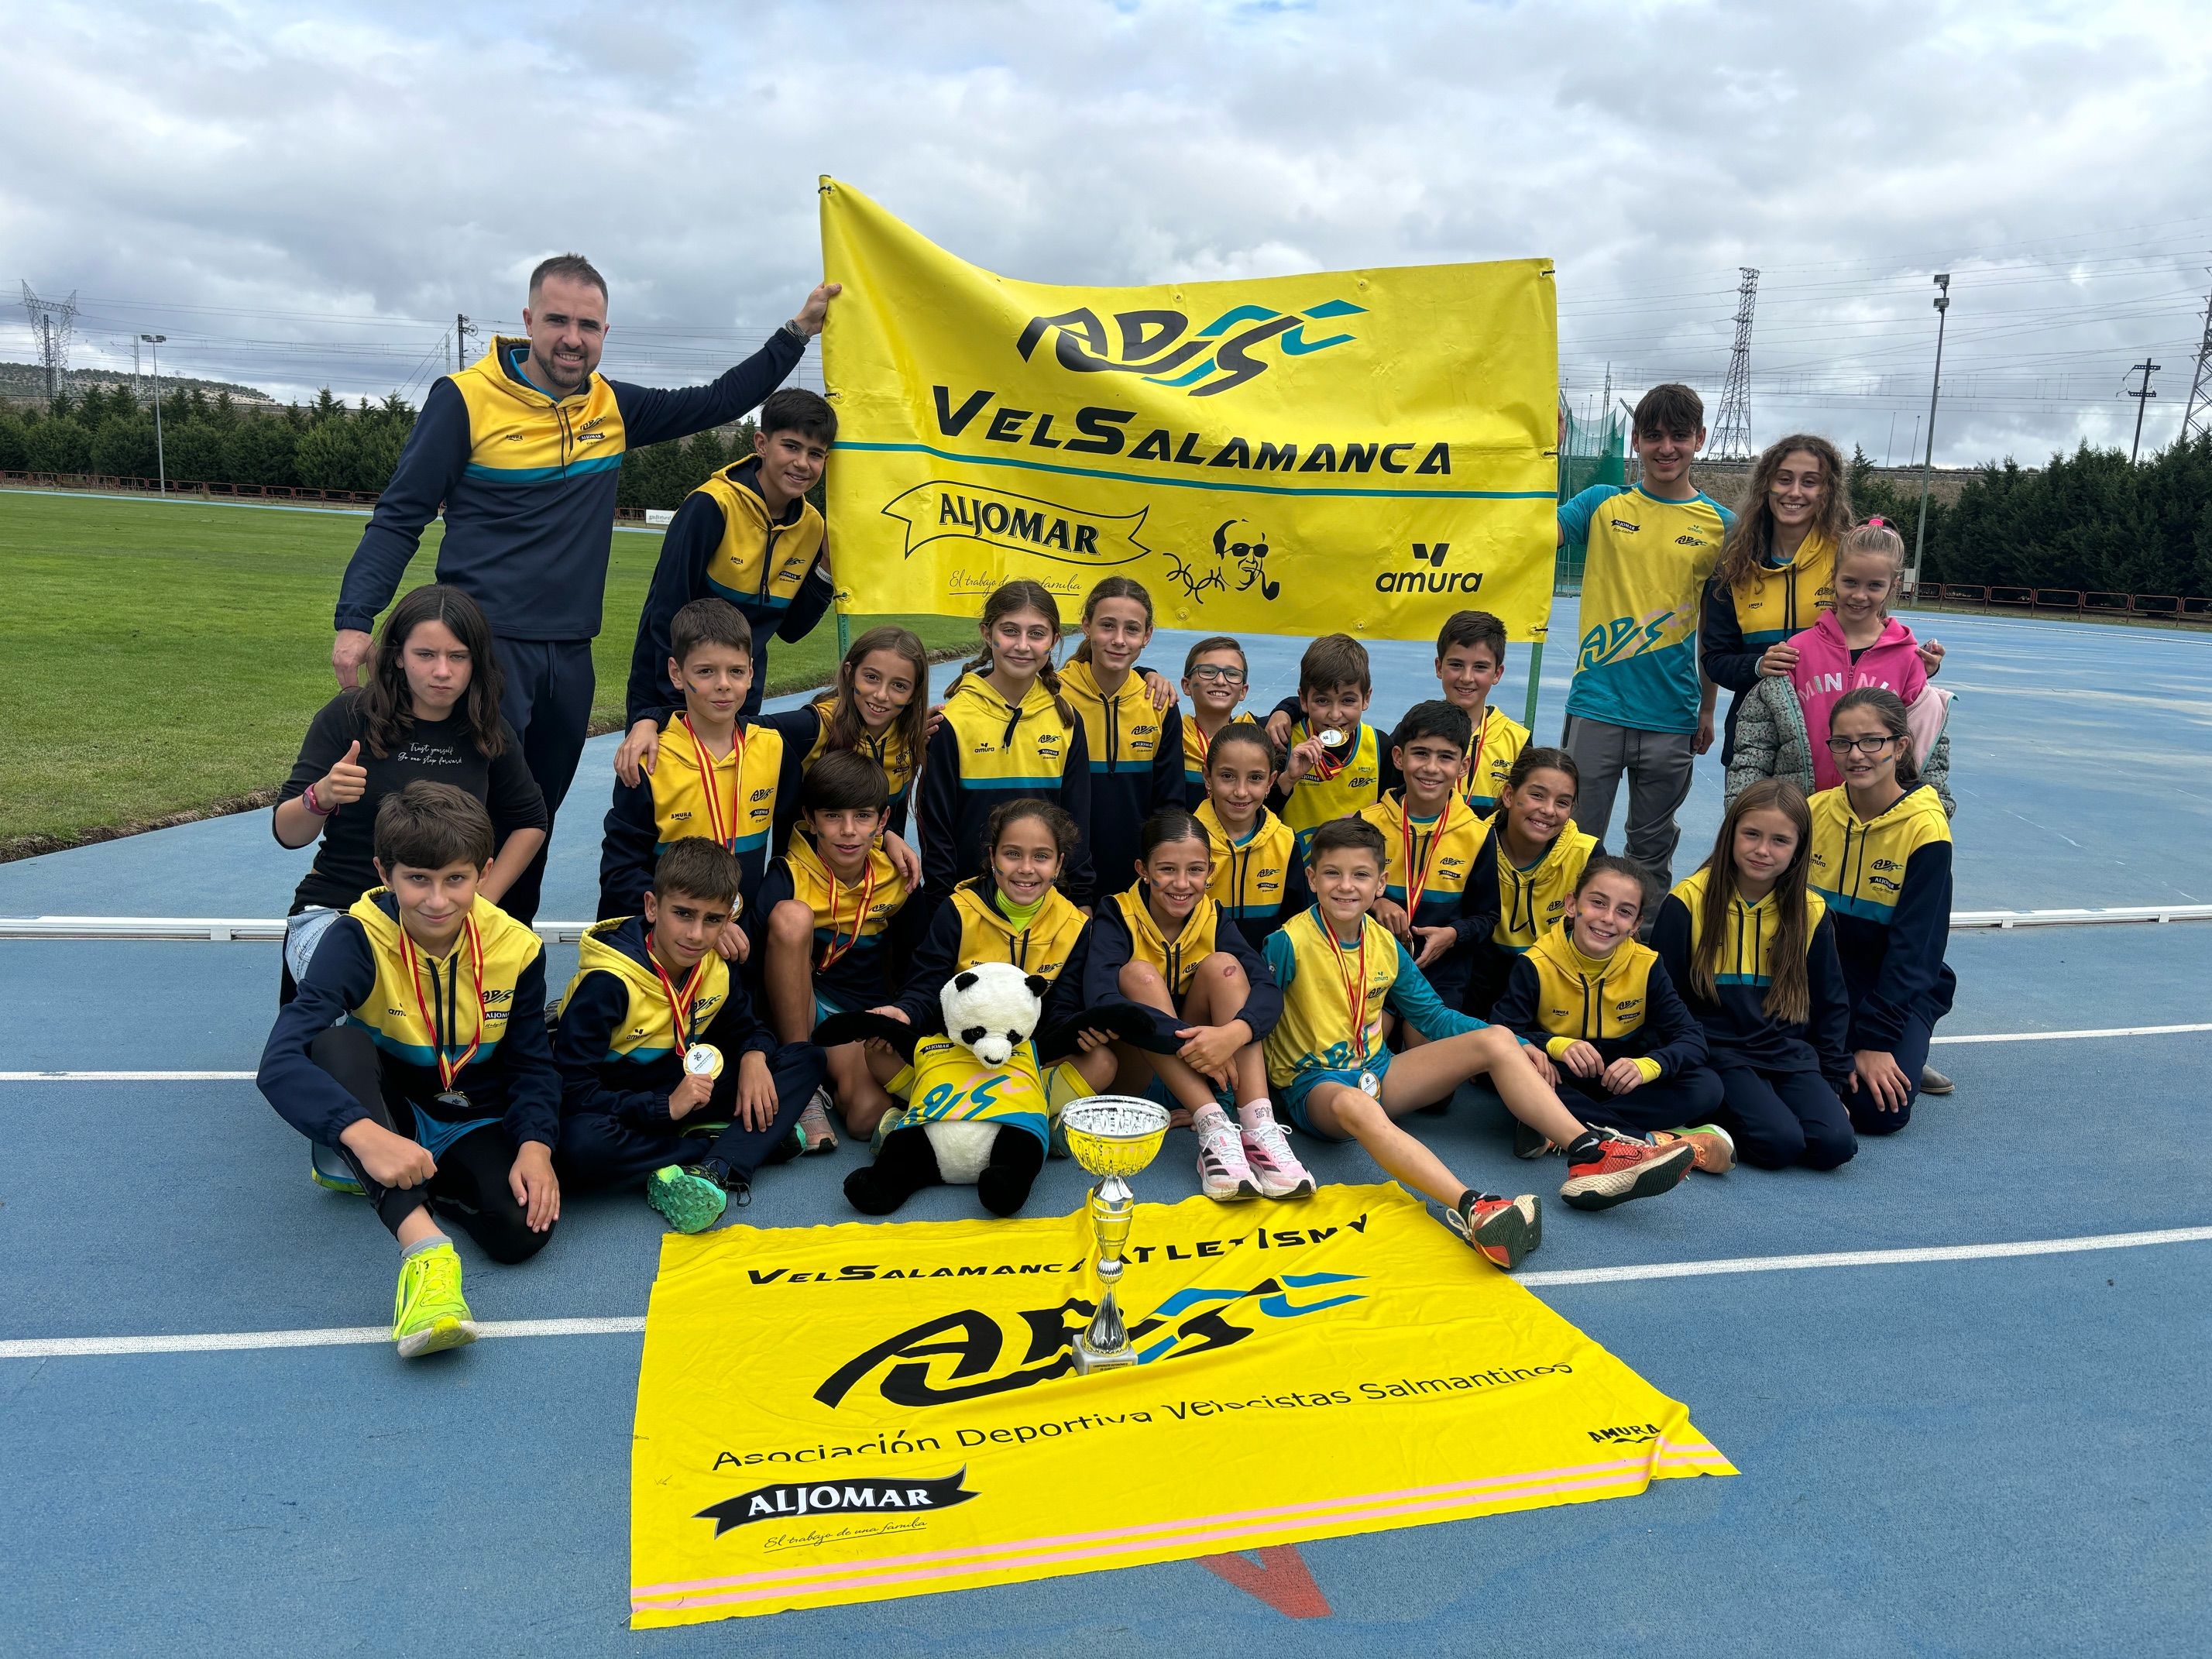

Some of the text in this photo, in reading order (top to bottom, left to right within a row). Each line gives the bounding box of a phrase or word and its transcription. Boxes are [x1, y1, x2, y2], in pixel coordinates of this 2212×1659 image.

[939, 493, 1101, 555] ALJOMAR
[949, 569, 966, 588] El
[966, 570, 997, 598] trabajo
[1376, 571, 1483, 593] amura
[397, 751, 409, 761] Go
[422, 754, 437, 765] step
[438, 756, 463, 765] forward
[410, 743, 454, 756] Trust yourself
[956, 1411, 1152, 1448] Deportiva
[1587, 1424, 1661, 1443] AMURA
[747, 1486, 934, 1516] ALJOMAR
[764, 1537, 785, 1549] El
[786, 1530, 833, 1548] trabajo
[854, 1525, 878, 1534] una
[877, 1516, 928, 1535] familia
